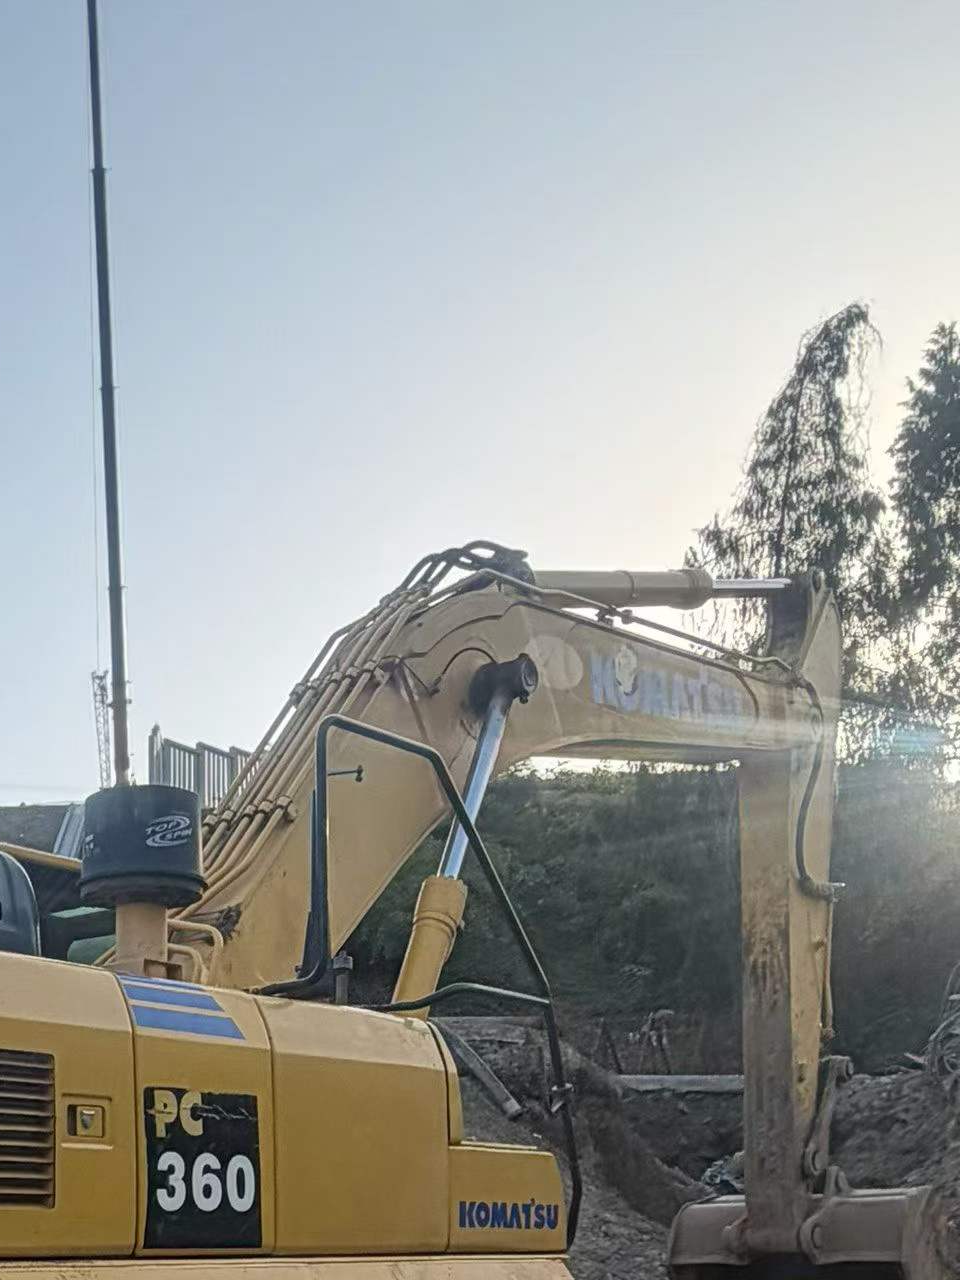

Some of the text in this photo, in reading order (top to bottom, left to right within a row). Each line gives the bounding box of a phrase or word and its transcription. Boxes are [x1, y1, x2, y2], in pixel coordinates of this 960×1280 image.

[153, 1089, 205, 1138] PC
[156, 1151, 256, 1213] 360
[458, 1198, 559, 1230] KOMATSU
